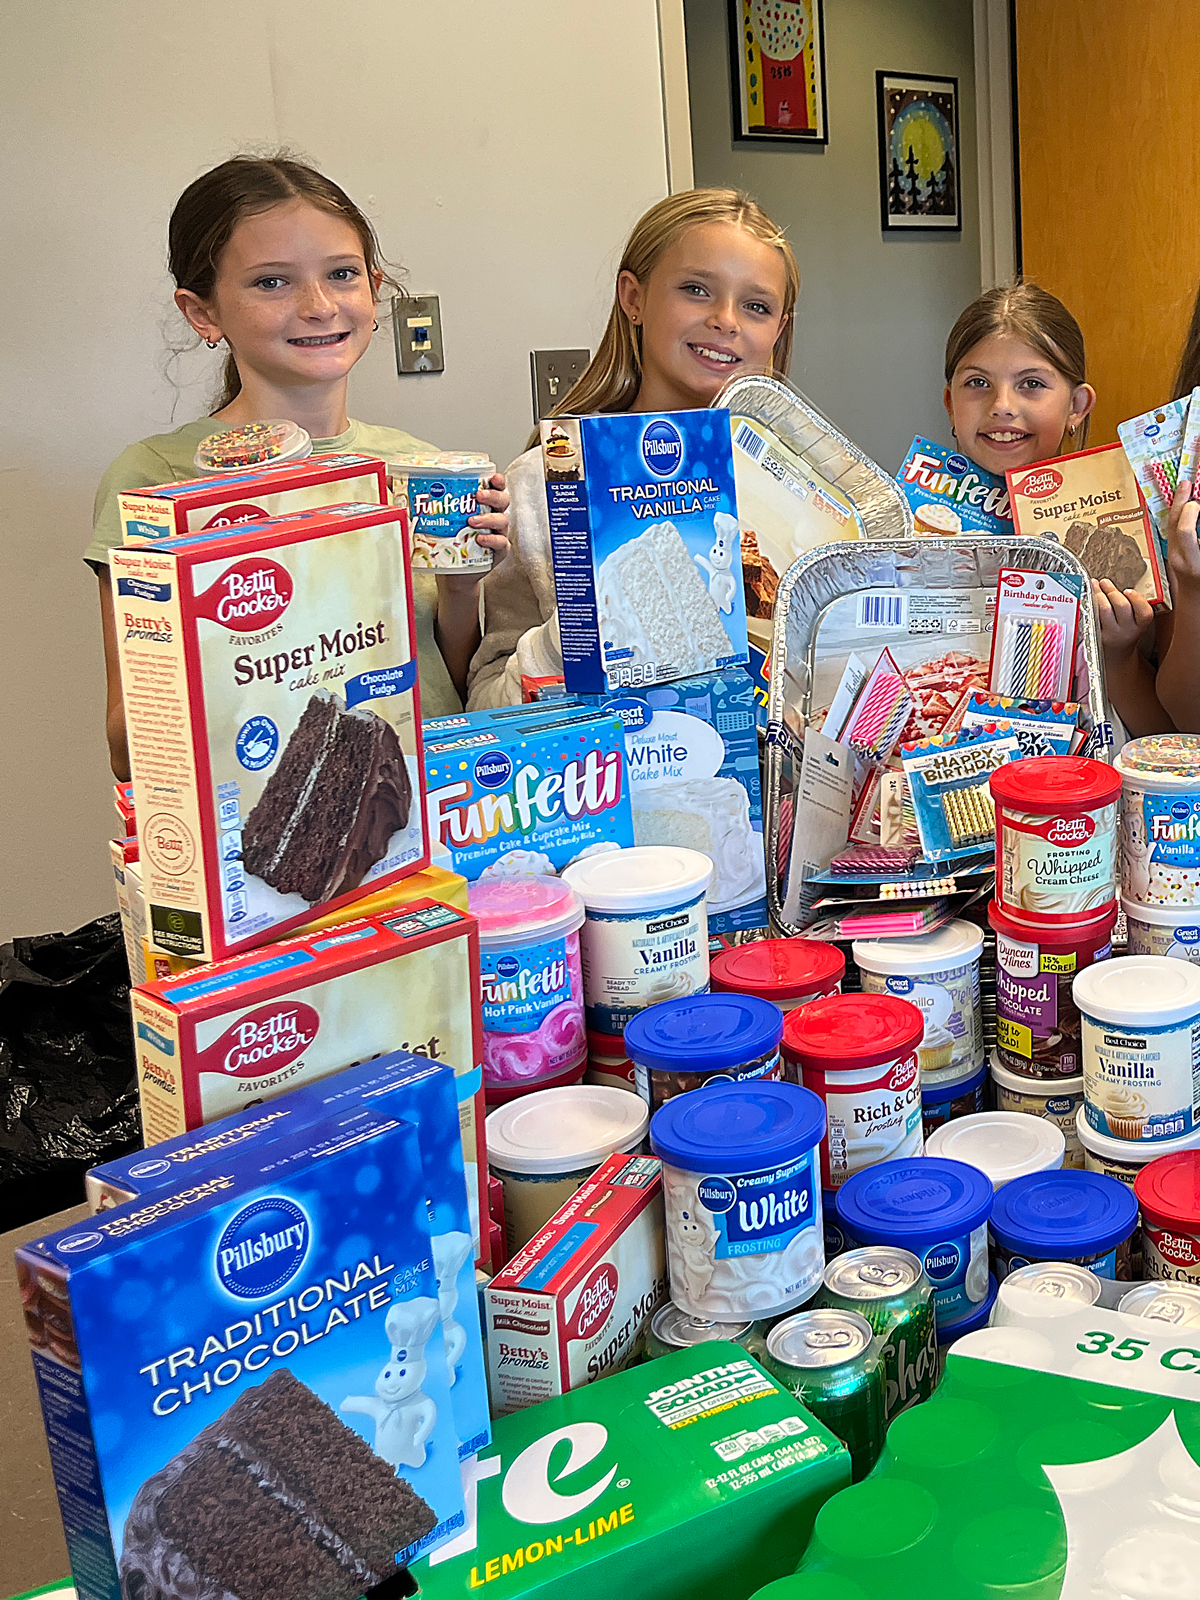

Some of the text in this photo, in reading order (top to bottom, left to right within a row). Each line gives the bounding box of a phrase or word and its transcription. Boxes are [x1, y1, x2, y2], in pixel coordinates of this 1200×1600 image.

[644, 438, 680, 458] Pillsbury
[608, 477, 719, 502] TRADITIONAL
[1023, 481, 1060, 496] Crocker
[1026, 472, 1053, 486] Betty
[414, 493, 476, 515] Funfetti
[631, 498, 703, 520] VANILLA
[1033, 489, 1122, 520] Super Moist
[420, 517, 450, 527] Vanilla
[222, 568, 275, 600] Betty
[217, 592, 288, 622] Crocker
[1004, 589, 1074, 605] Birthday Candles
[124, 613, 172, 632] Betty's
[124, 627, 173, 643] promise
[228, 623, 284, 647] FAVORITES
[234, 620, 386, 686] Super Moist
[360, 669, 404, 686] Chocolate
[369, 683, 397, 696] Fudge
[631, 732, 679, 745] Deluxe Moist
[627, 745, 688, 766] White
[933, 748, 994, 769] HAPPY
[475, 762, 511, 779] Pillsbury
[924, 754, 1005, 782] BIRTHDAY
[426, 750, 620, 848] Funfetti
[1047, 829, 1092, 842] Crocker
[1052, 818, 1087, 833] Betty
[455, 821, 591, 865] Premium Cake & Cupcake Mix
[1158, 843, 1194, 855] Vanilla
[1027, 849, 1103, 876] Whipped
[1047, 849, 1091, 859] FROSTING
[1035, 872, 1099, 886] Cream Cheese
[648, 915, 689, 933] Best Choice
[1176, 928, 1198, 937] Great
[639, 938, 696, 966] Vanilla
[998, 941, 1034, 960] Duncan
[1043, 956, 1060, 965] 15%
[1001, 955, 1032, 968] Hines
[480, 960, 565, 1003] Funfetti
[607, 984, 630, 992] SPREAD
[888, 977, 909, 988] Great
[484, 993, 564, 1017] Hot Pink Vanilla
[231, 1009, 298, 1048] Betty
[224, 1032, 313, 1072] Crocker
[1106, 1036, 1145, 1049] Best Choice
[237, 1060, 305, 1093] FAVORITES
[1098, 1056, 1155, 1079] Vanilla
[1095, 1072, 1162, 1087] CREAMY FROSTING
[737, 1157, 809, 1188] Creamy Supreme
[98, 1172, 235, 1231] TRADITIONAL
[699, 1187, 734, 1202] Pillsbury
[739, 1189, 808, 1233] White
[220, 1220, 306, 1278] Pillsbury
[727, 1238, 781, 1255] FROSTING
[1158, 1241, 1200, 1263] Crocker
[1161, 1232, 1193, 1253] Betty
[393, 1257, 430, 1287] CAKE
[926, 1253, 959, 1270] Pillsbury
[394, 1277, 419, 1299] MIX
[139, 1254, 396, 1388] TRADITIONAL
[496, 1318, 548, 1332] Milk Chocolate
[152, 1281, 392, 1417] CHOCOLATE
[499, 1343, 549, 1361] Betty's
[1075, 1331, 1152, 1362] 35
[498, 1354, 549, 1370] promise
[644, 1360, 754, 1405] JOIN THE
[655, 1378, 735, 1413] SQUAD
[669, 1383, 768, 1422] ACCESS OFFERS PERKS
[668, 1395, 752, 1430] TEXT THIRST TO
[718, 1441, 737, 1454] 140
[470, 1502, 635, 1590] LEMON-LIME
